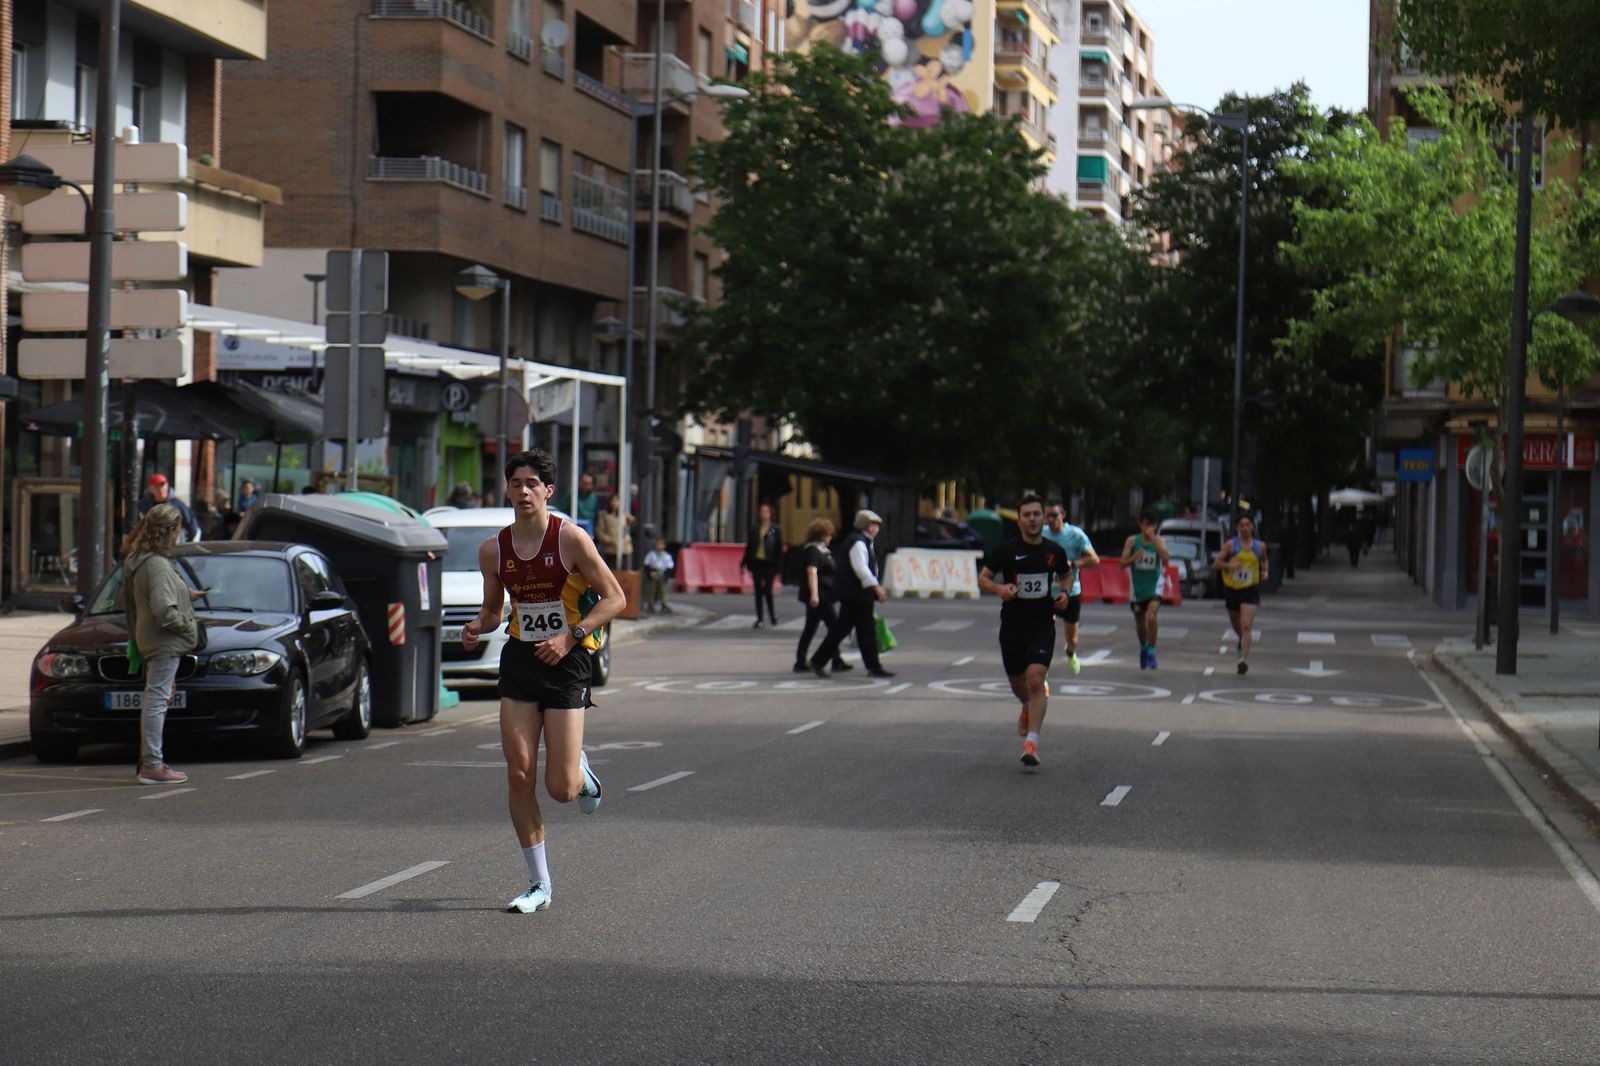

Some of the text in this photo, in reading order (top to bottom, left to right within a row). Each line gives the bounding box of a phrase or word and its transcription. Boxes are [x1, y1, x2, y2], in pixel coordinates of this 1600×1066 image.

[1024, 580, 1042, 593] 32
[522, 612, 563, 632] 246
[116, 694, 142, 707] 186
